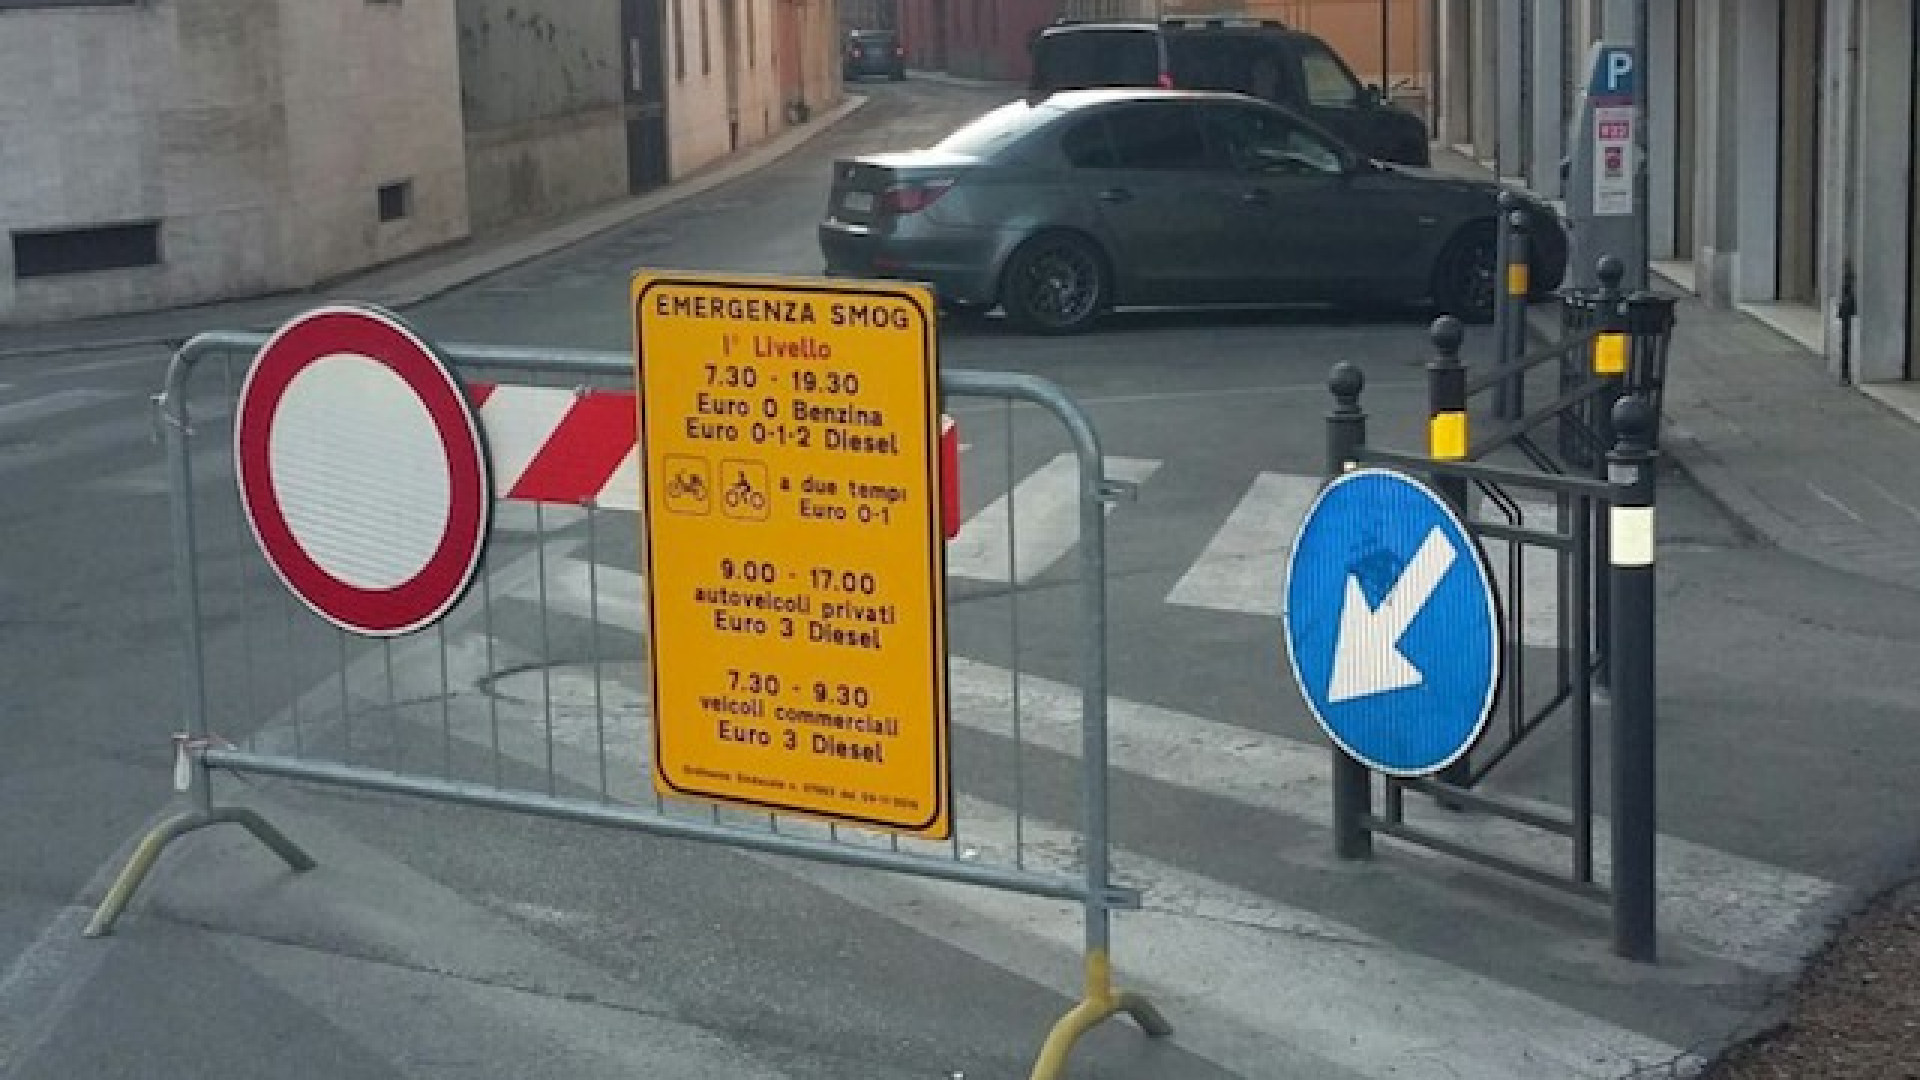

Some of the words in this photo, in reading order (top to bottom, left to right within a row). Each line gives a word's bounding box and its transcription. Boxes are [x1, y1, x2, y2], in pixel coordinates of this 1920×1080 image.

[656, 294, 816, 324] EMERGENZA
[831, 303, 911, 330] SMOG
[754, 336, 832, 360] Livello
[704, 363, 757, 388] 7.30
[792, 370, 859, 396] 19.30
[697, 393, 750, 415] Euro
[792, 401, 884, 427] Benzina
[686, 417, 739, 441] Euro
[752, 422, 810, 447] 0-1-2
[825, 428, 899, 455] Diesel
[801, 475, 838, 494] due
[848, 481, 907, 504] tempi
[800, 498, 847, 519] Euro
[857, 504, 889, 524] 0-1
[720, 558, 776, 583] 9.00
[810, 568, 876, 594] 17.00
[695, 587, 811, 615] autoveicoli
[821, 599, 896, 624] privati
[714, 608, 767, 634] Euro
[779, 617, 793, 638] 3
[809, 620, 882, 649] Diesel
[727, 669, 779, 696] 7.30
[812, 680, 869, 708] 9.30
[699, 695, 765, 717] veicoli
[774, 707, 899, 736] commerciali
[718, 719, 771, 745] Euro
[783, 728, 797, 750] 3
[812, 732, 884, 763] Diesel
